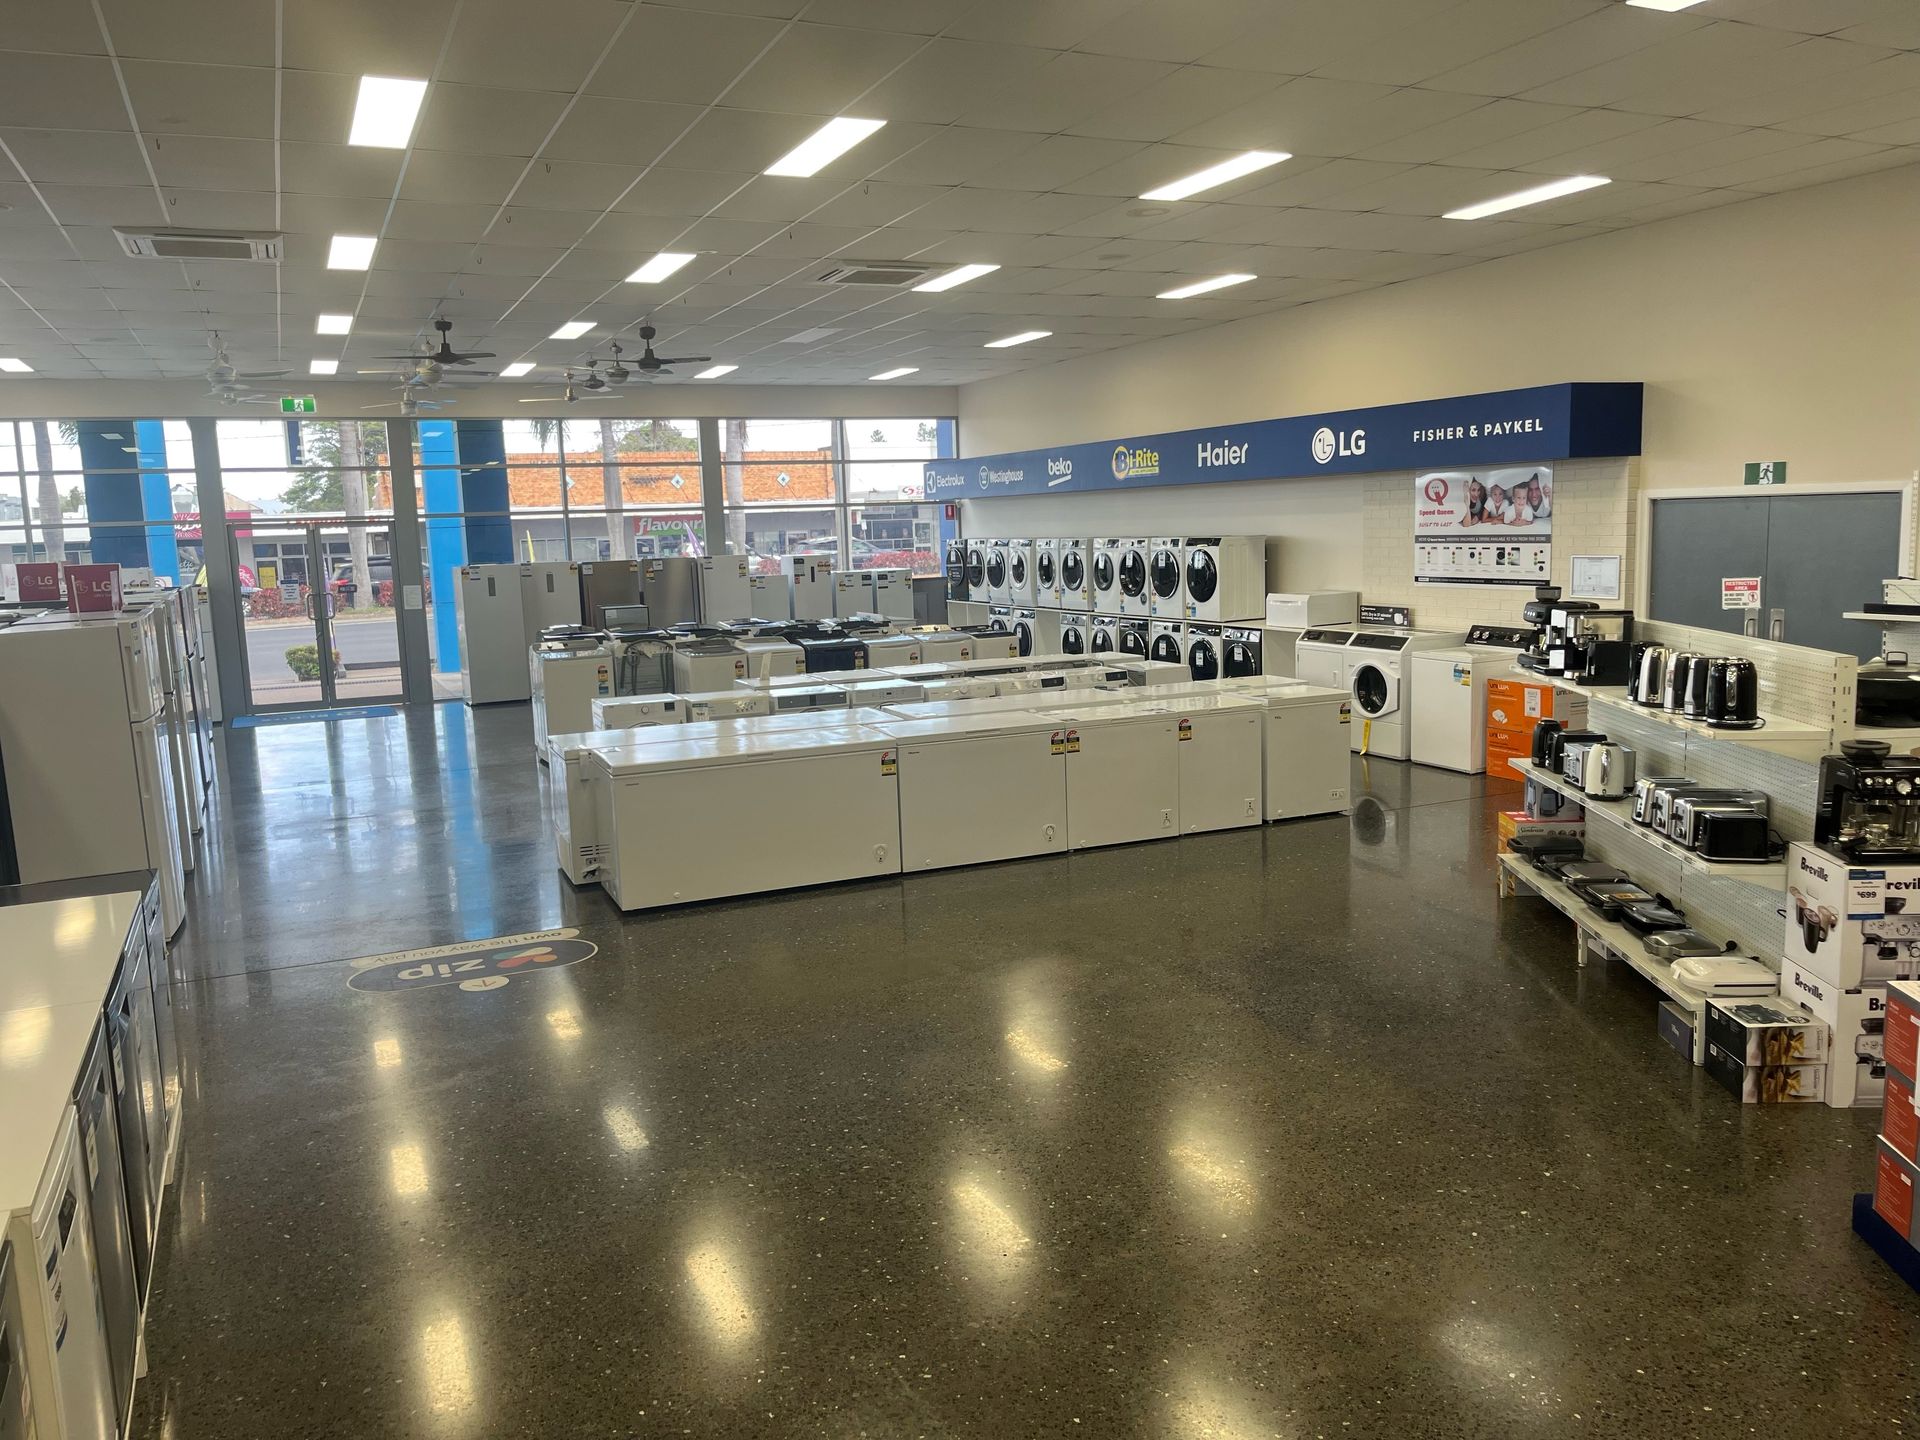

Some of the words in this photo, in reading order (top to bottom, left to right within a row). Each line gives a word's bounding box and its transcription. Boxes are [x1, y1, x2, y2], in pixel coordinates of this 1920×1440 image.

[1413, 427, 1464, 442] FISHER
[1469, 426, 1479, 438] &
[1484, 419, 1544, 435] PAYKEL
[1339, 430, 1366, 457] LG
[1198, 441, 1249, 467] Haier
[1048, 458, 1073, 475] beko
[936, 472, 965, 487] Electrolux
[989, 469, 1024, 485] Westinghouse
[1419, 509, 1436, 517] Speed
[636, 518, 703, 535] flavour
[38, 576, 53, 585] LG
[93, 581, 111, 592] LG
[1801, 857, 1829, 882] Breville
[1886, 877, 1920, 890] revil
[1857, 891, 1877, 899] $699
[492, 937, 520, 947] the
[523, 931, 563, 941] own
[411, 946, 448, 958] you
[450, 940, 493, 952] way
[398, 958, 487, 980] zip
[1795, 972, 1824, 1001] Breville
[1869, 997, 1886, 1011] Br
